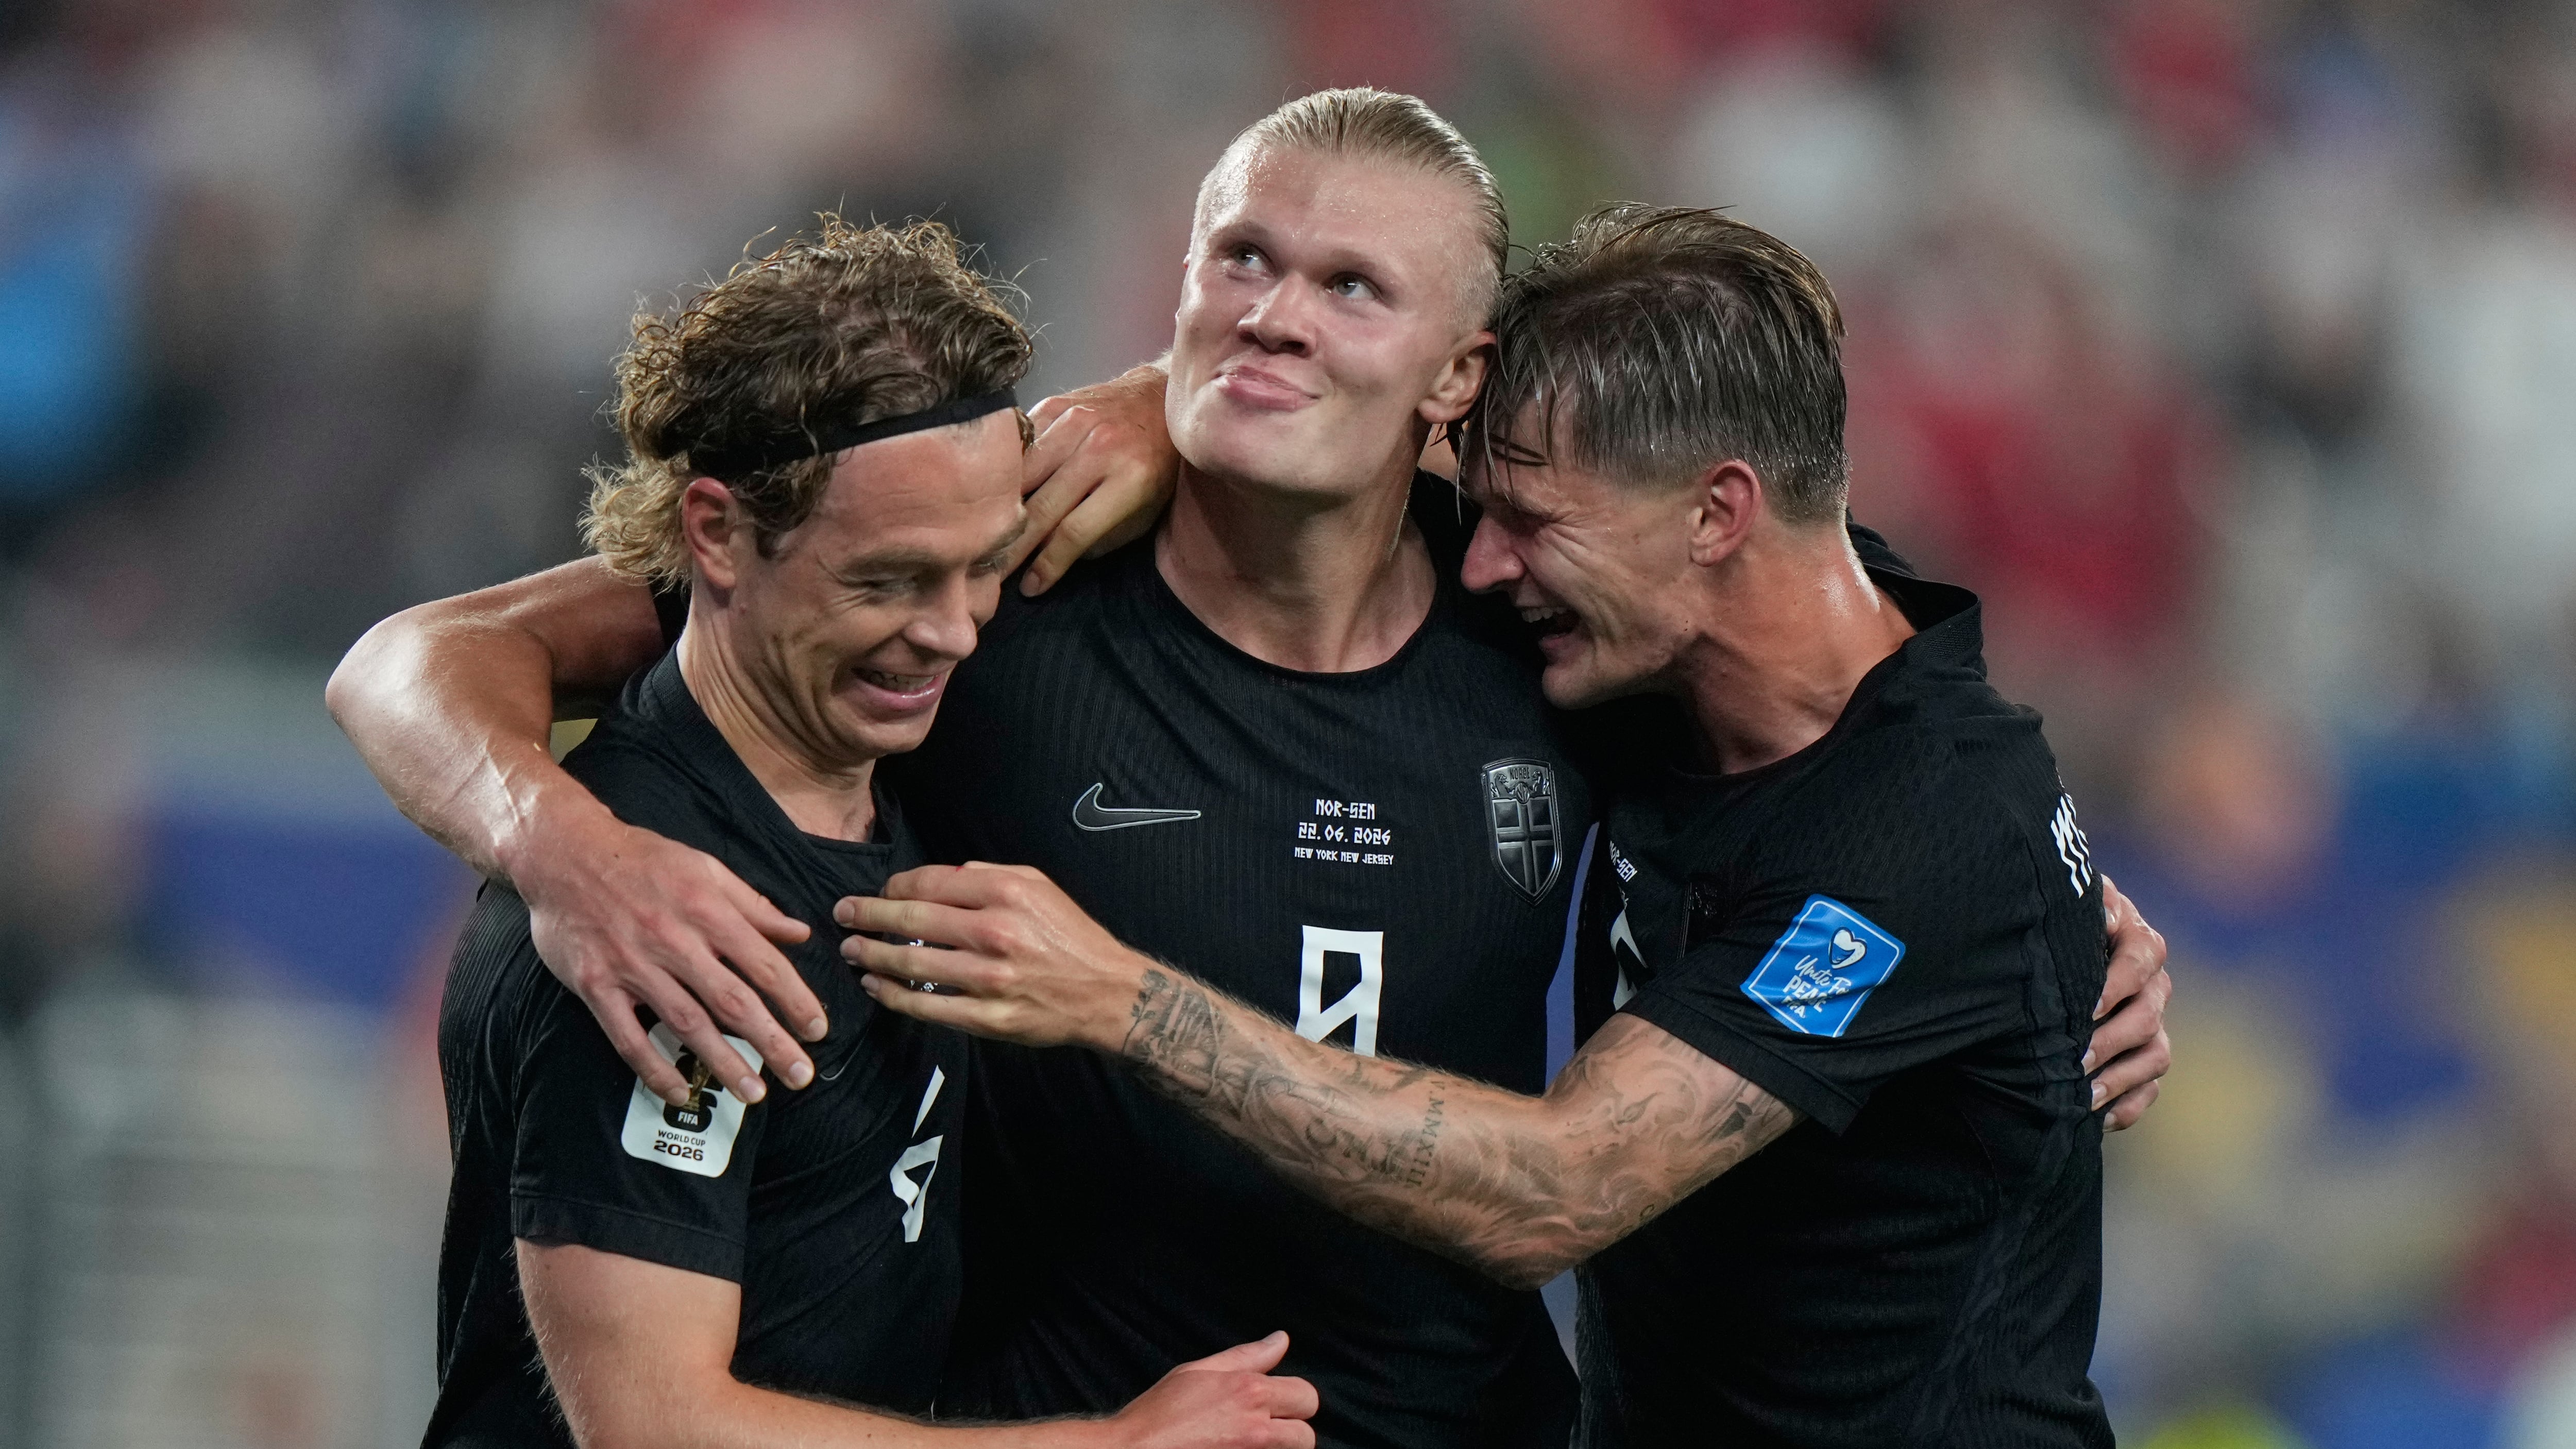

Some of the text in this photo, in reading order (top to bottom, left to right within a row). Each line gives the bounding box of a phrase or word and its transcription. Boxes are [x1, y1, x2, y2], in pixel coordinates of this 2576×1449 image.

[1315, 799, 1376, 820] NOR-SEN
[1295, 847, 1394, 865] NEW YORK NEW JERSEY
[1794, 955, 1852, 995] Unite Fo
[677, 1111, 699, 1125] FIFA
[658, 1129, 706, 1147] WORLD CUP
[653, 1140, 704, 1161] 2026
